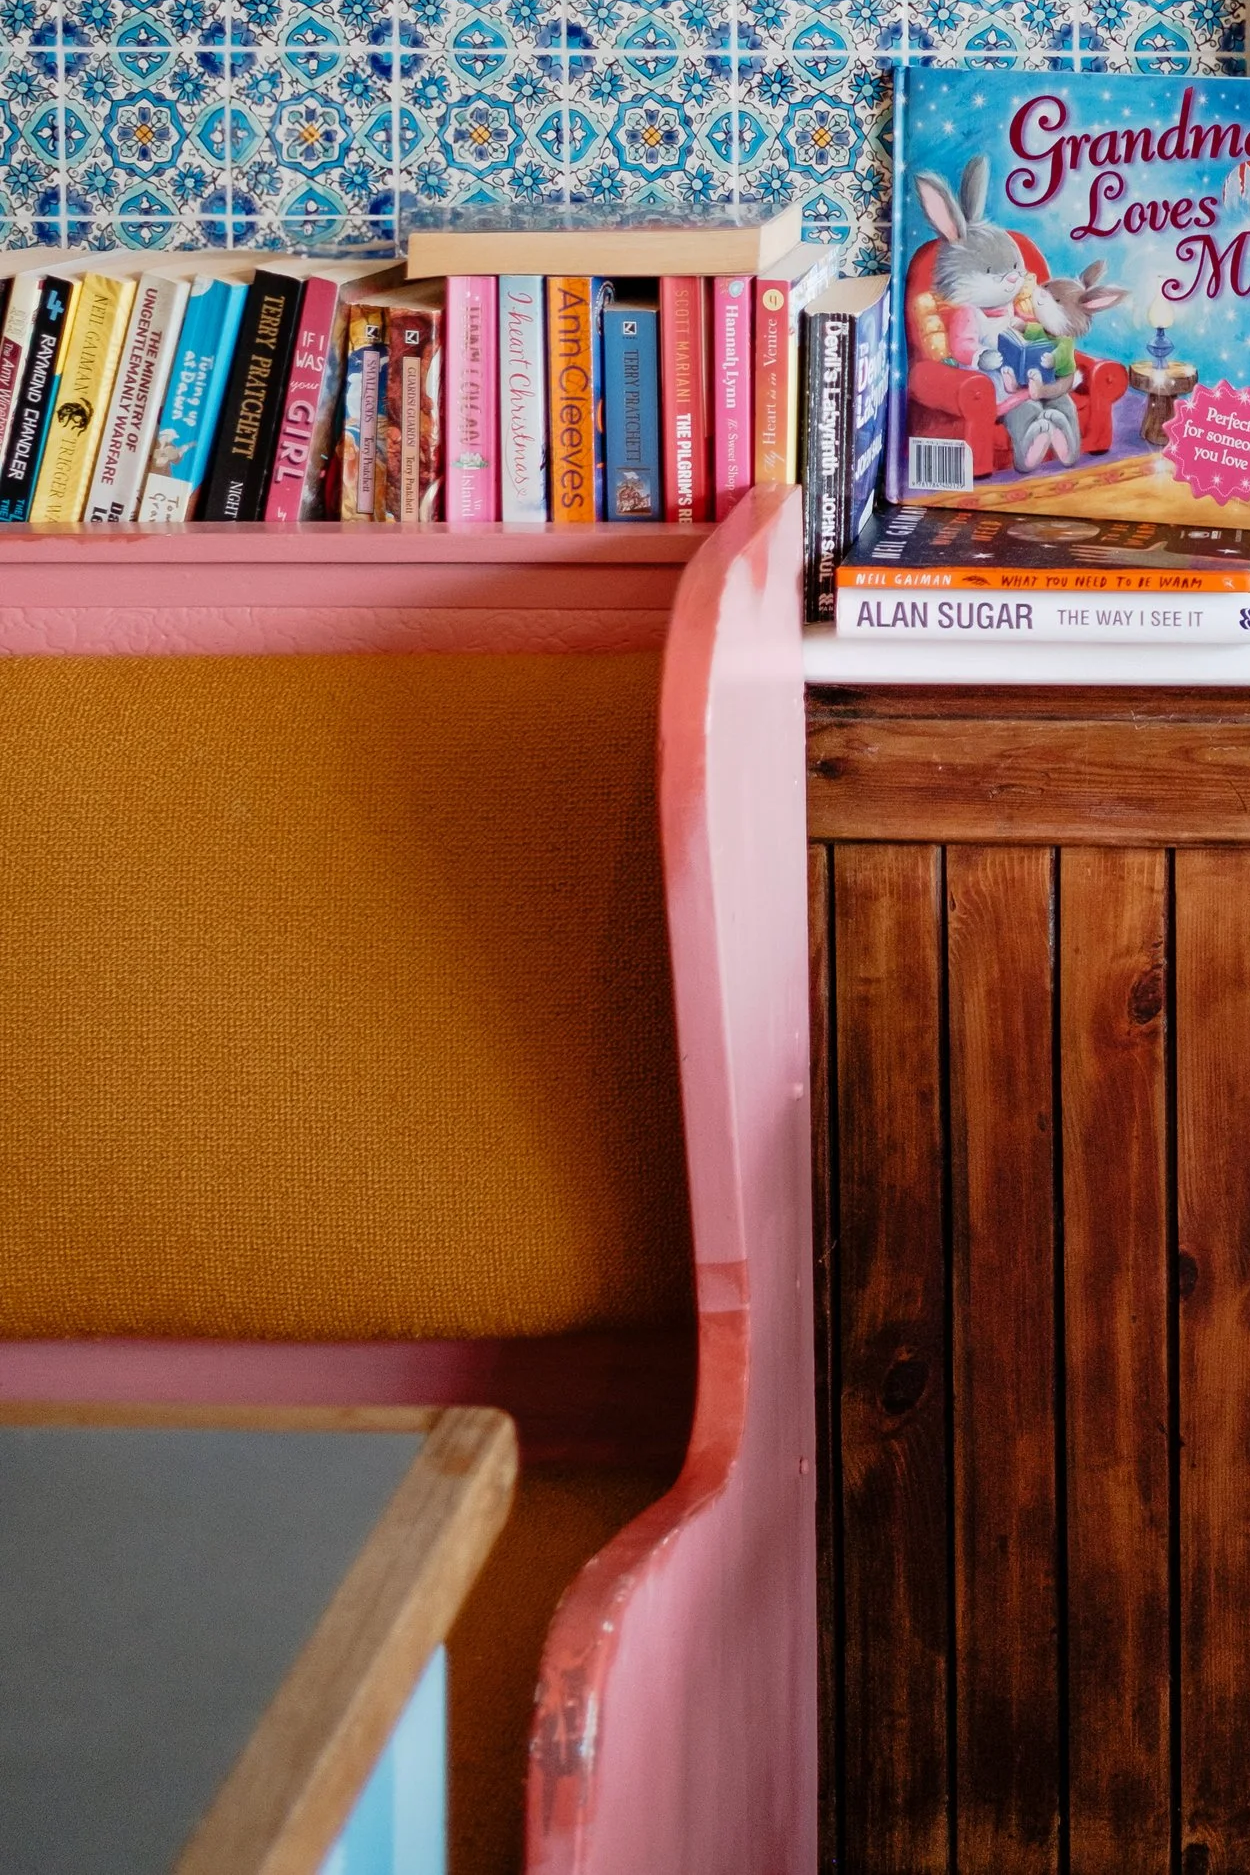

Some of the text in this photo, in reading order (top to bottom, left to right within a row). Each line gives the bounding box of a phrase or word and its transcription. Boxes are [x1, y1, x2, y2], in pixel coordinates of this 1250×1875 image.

[1070, 171, 1218, 240] Loves
[73, 294, 110, 395] NEIL GAIMAN
[295, 350, 324, 372] WAS
[302, 331, 324, 352] IF I
[507, 309, 533, 369] heart
[674, 289, 691, 403] SCOTT MARIANI
[722, 305, 739, 409] Hannah Lynn
[764, 318, 778, 366] Venice
[824, 321, 842, 383] Devil's
[0, 357, 15, 387] Amy
[101, 288, 158, 486] UNGENTLEMANLY WARFARE
[125, 331, 163, 453] THE MINISTRY OF
[172, 350, 196, 421] at Dawn
[231, 295, 286, 461] TERRY PRATCHETT
[289, 379, 320, 393] your
[364, 359, 380, 423] SMALL GODS
[623, 349, 639, 388] TERRY
[768, 372, 777, 386] in
[769, 389, 777, 400] is
[7, 333, 57, 481] RAYMOND CHANDLER
[183, 408, 198, 427] up
[406, 366, 417, 447] GUARDS! GUARDS!
[557, 287, 589, 509] Ann Cleeves
[763, 403, 777, 445] Heart
[274, 400, 316, 483] GIRL
[508, 373, 535, 485] Christmas
[624, 391, 642, 463] PRATCHETT
[676, 413, 692, 438] THE
[727, 433, 739, 462] Sweet
[819, 386, 841, 476] Labyrinth
[1183, 419, 1204, 438] for
[49, 438, 77, 499] TRIGGER
[362, 436, 375, 493] Terry Pratchett
[676, 440, 693, 507] PILGRIM'S
[725, 465, 739, 490] Shop
[1194, 446, 1249, 470] you love
[224, 480, 244, 520] NIGHT
[405, 456, 415, 514] Terry Pratchett
[462, 475, 475, 517] Island
[821, 493, 836, 537] JOHN
[819, 540, 835, 582] SAUL
[871, 540, 907, 559] NEIL
[855, 573, 1203, 589] NEIL GAIMAN WHAT YOU NEED TO BE WARM
[856, 600, 1203, 630] ALAN SUGAR THE WAY I SEE IT
